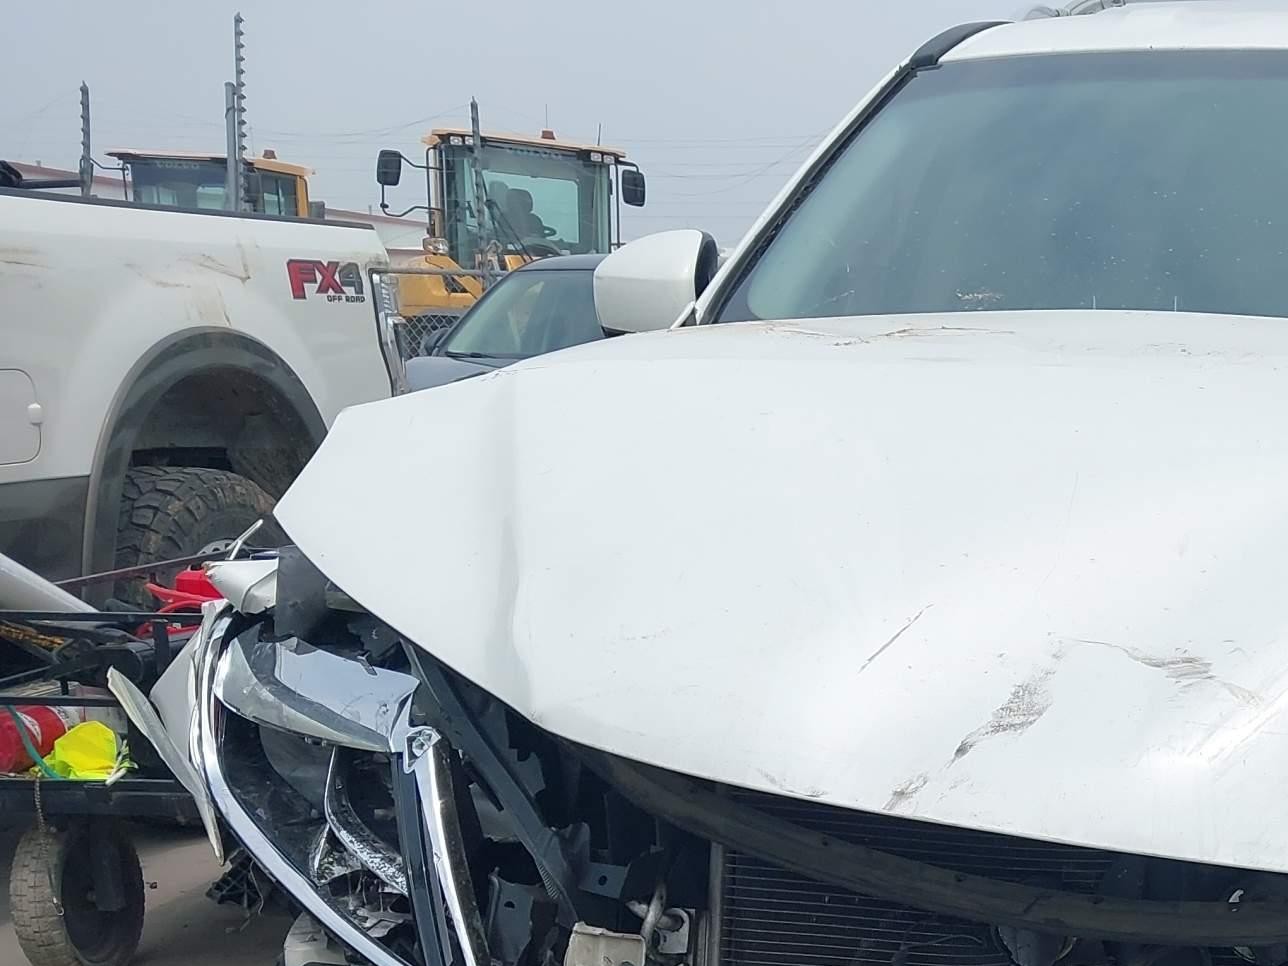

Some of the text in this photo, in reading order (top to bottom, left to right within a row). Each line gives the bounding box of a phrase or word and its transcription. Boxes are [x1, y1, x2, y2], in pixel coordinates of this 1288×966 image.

[286, 258, 364, 300] FX4
[326, 295, 366, 303] OFF ROAD
